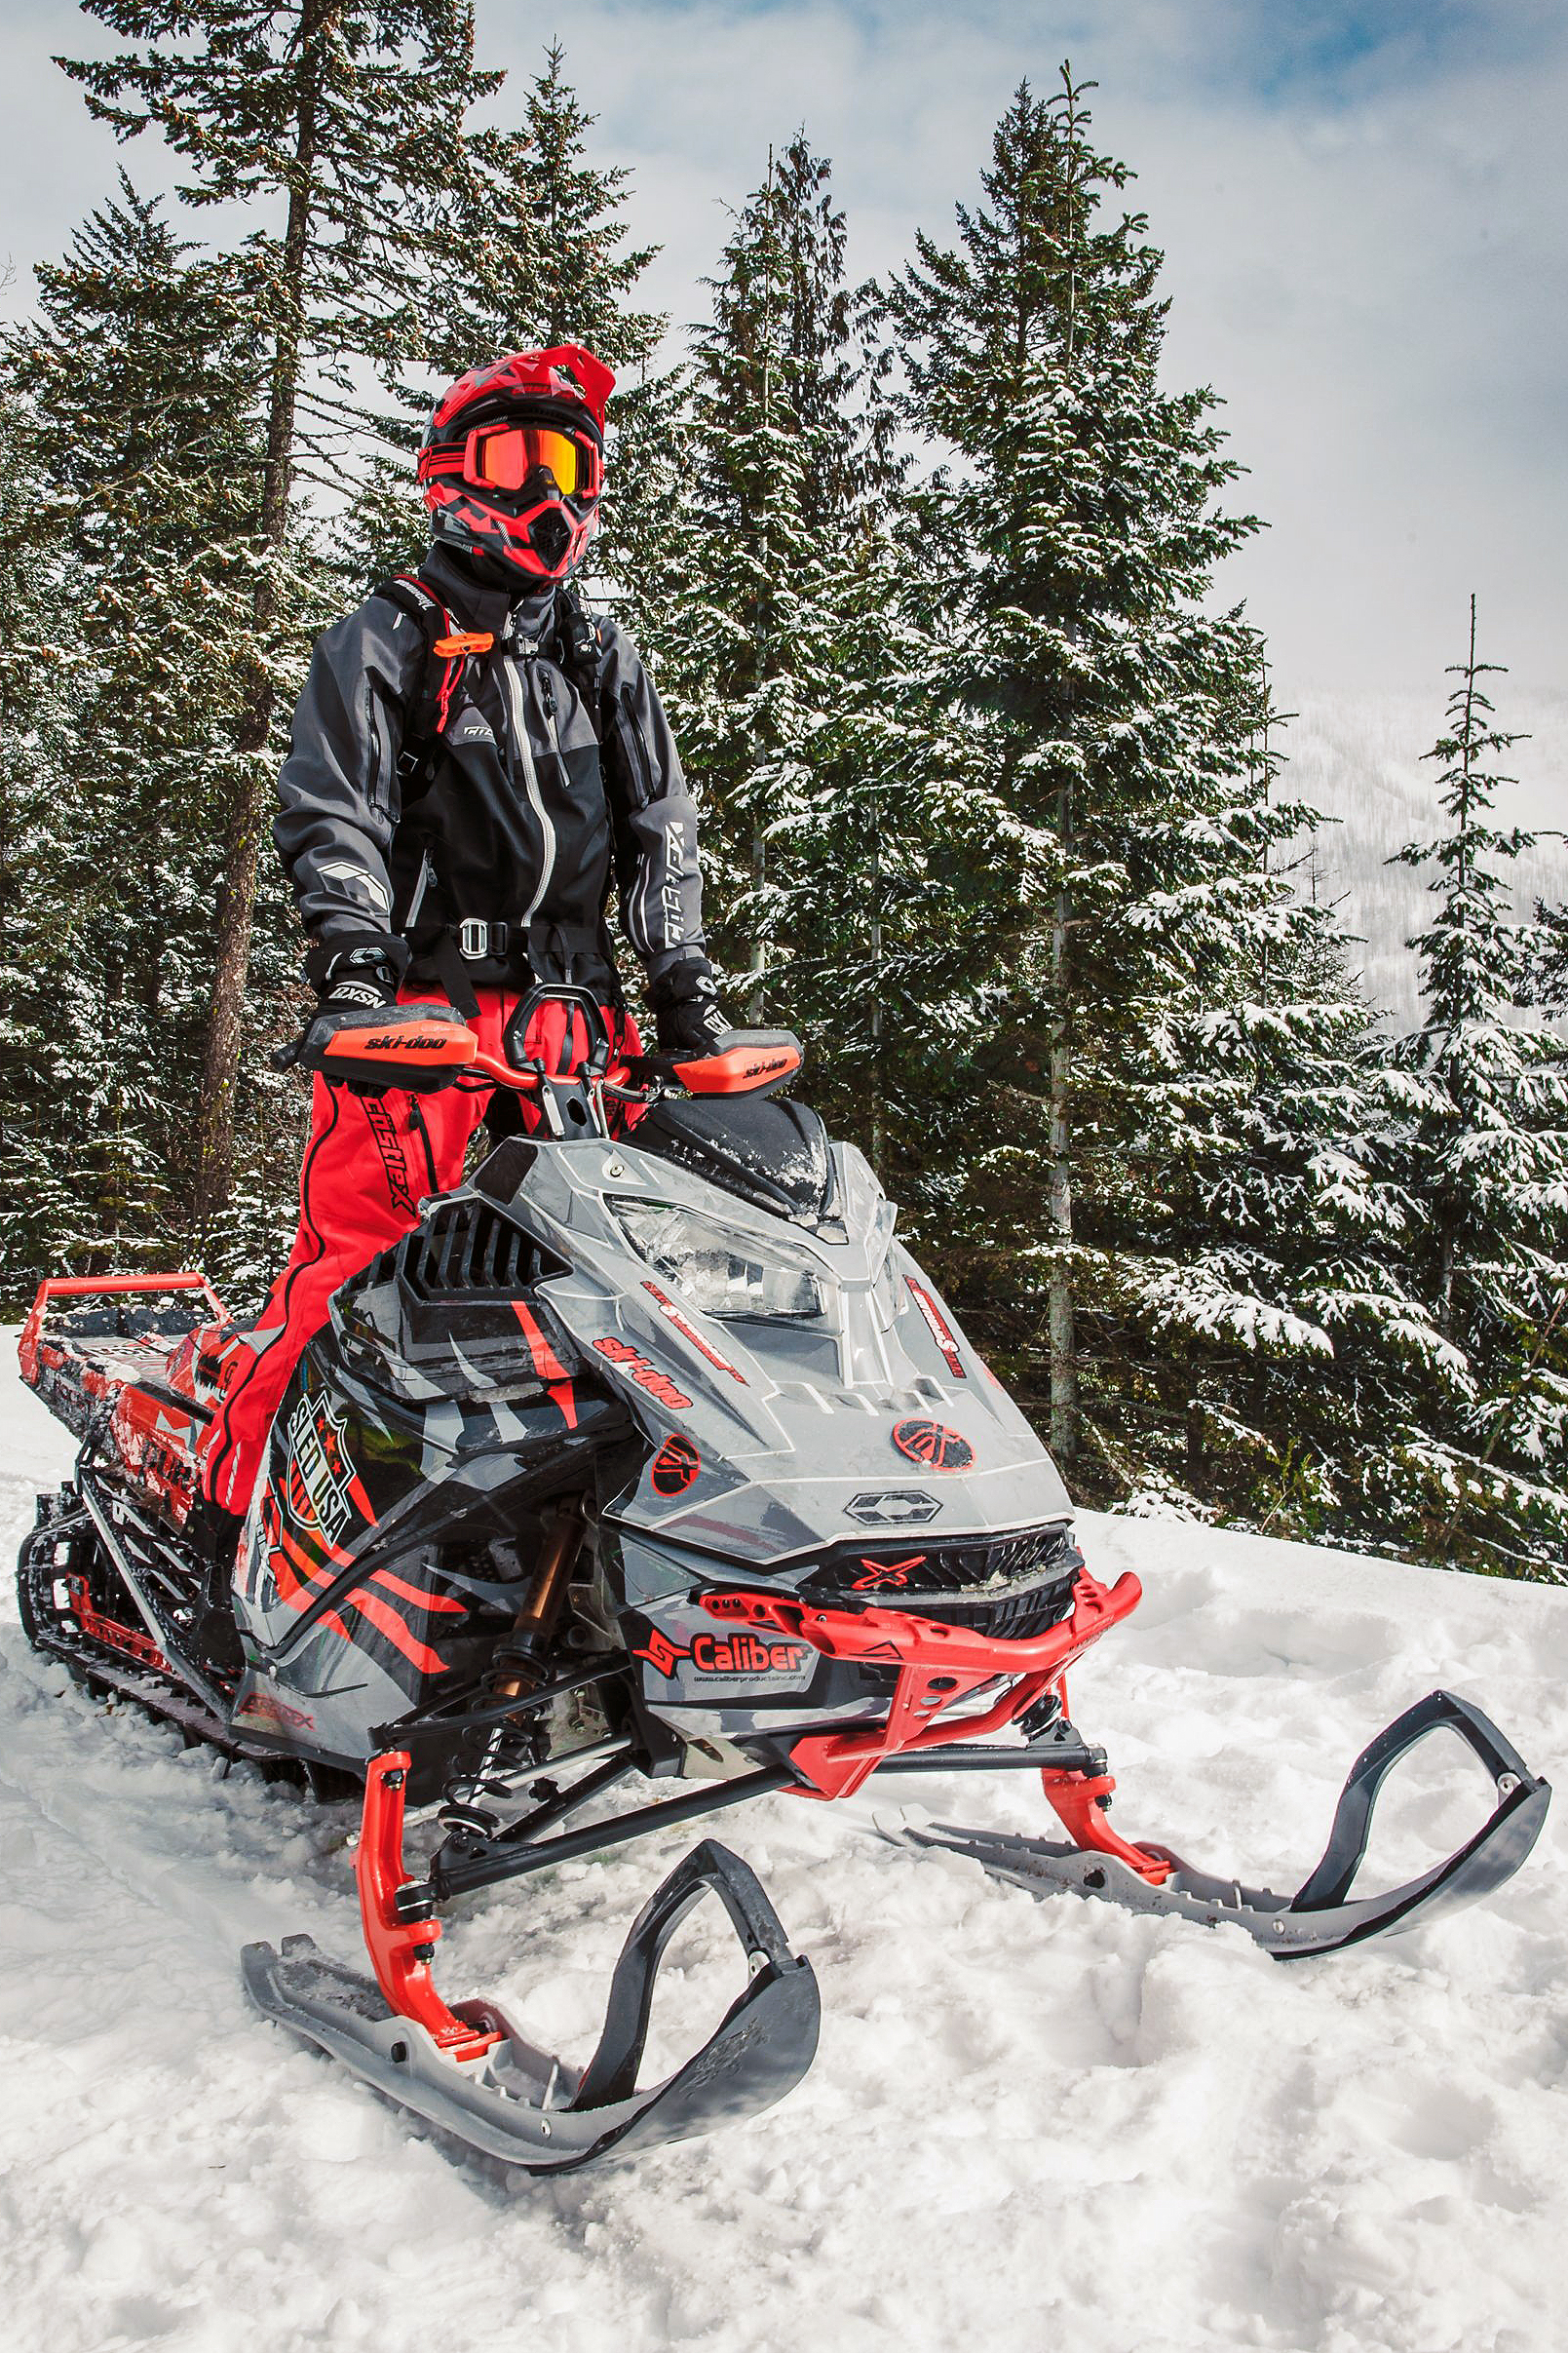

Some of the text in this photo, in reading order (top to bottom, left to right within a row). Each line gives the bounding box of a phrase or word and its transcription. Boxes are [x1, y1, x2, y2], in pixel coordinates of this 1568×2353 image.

[363, 1035, 448, 1050] ski-doo
[592, 1336, 694, 1409] ski-doo
[289, 1398, 349, 1546] SLED USA
[693, 1635, 811, 1672] Caliber
